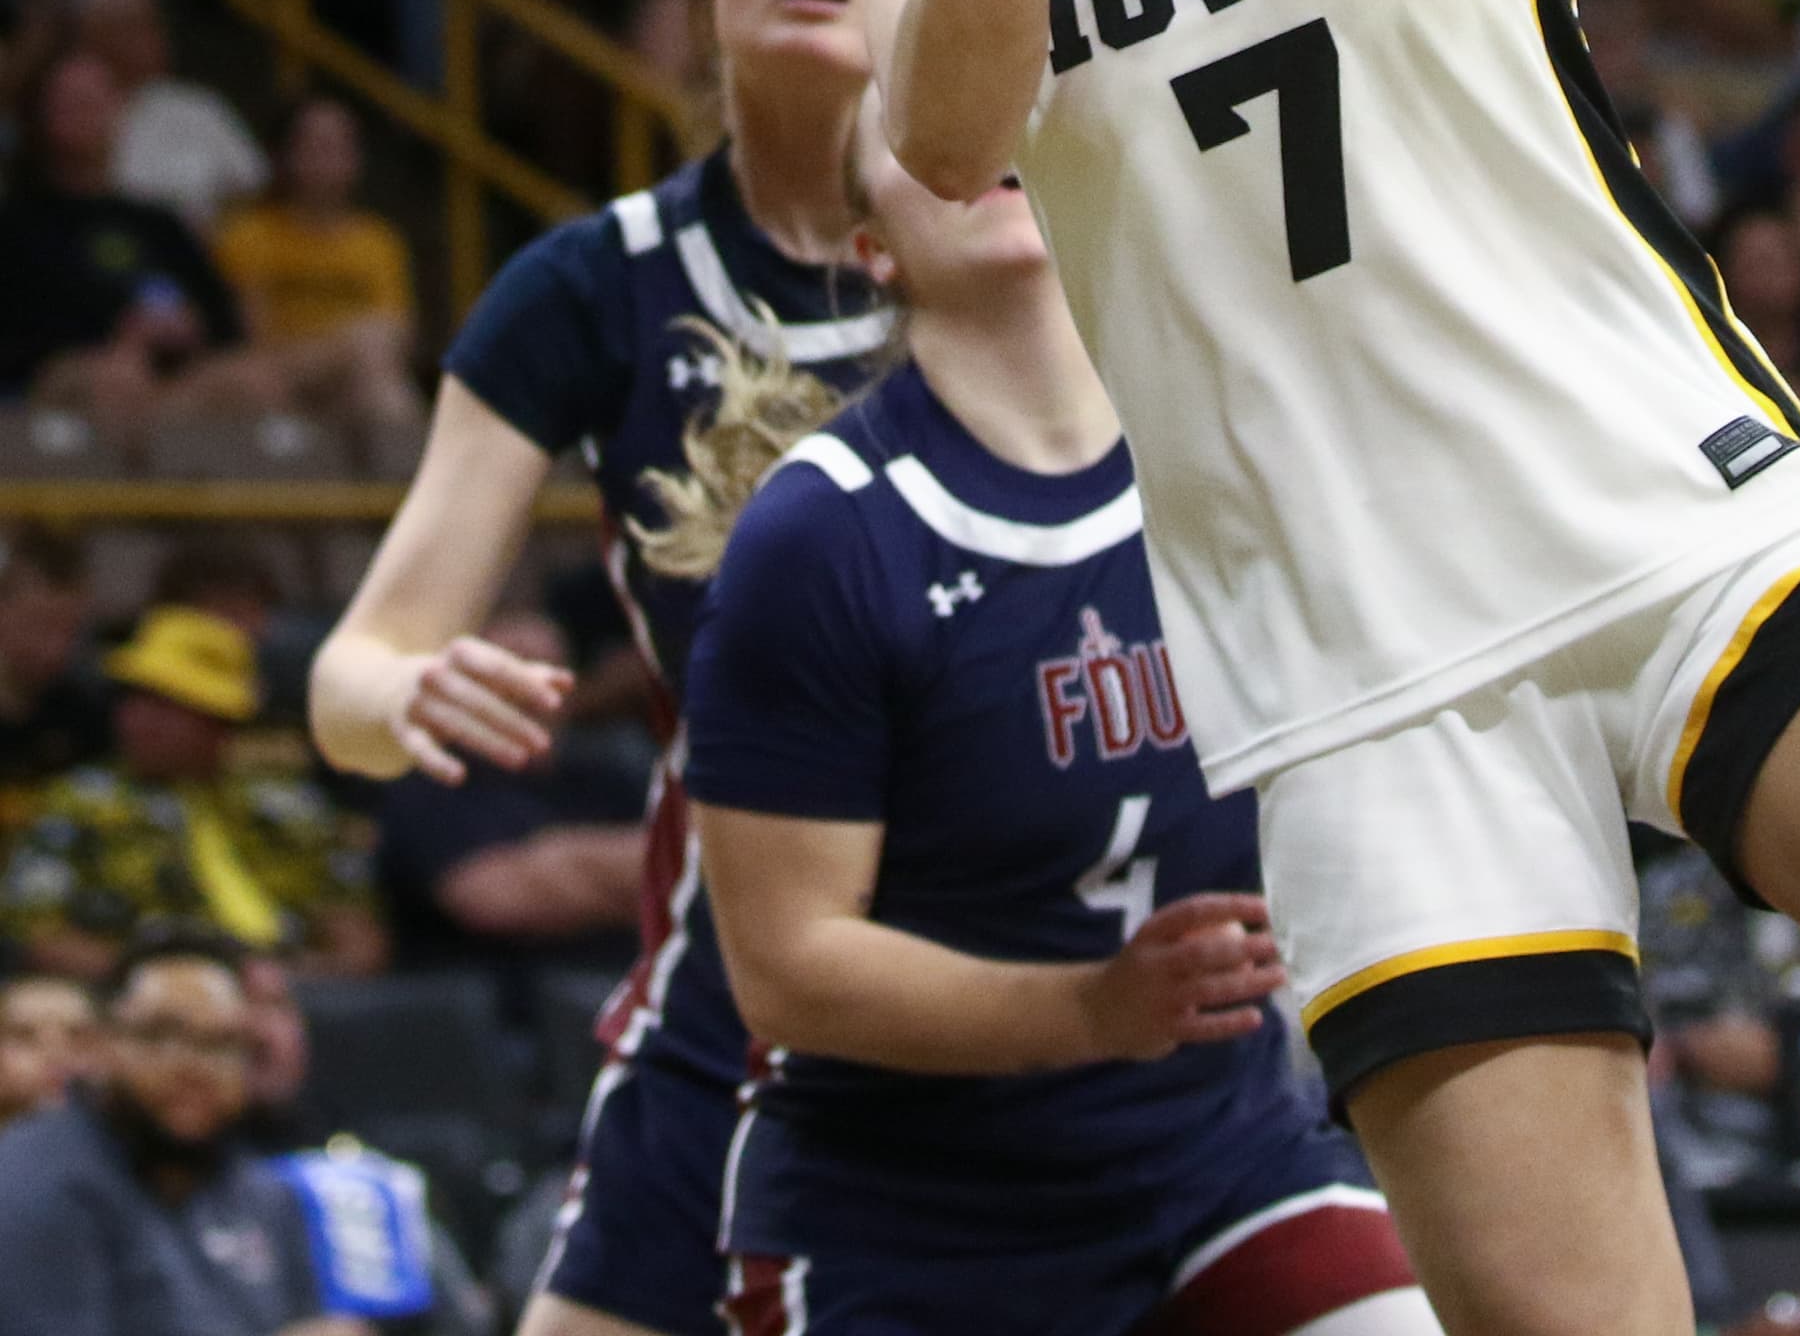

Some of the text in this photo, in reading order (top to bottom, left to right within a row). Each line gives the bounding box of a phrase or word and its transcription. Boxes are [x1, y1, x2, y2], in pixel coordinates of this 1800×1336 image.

[1169, 17, 1352, 283] 7
[1036, 637, 1192, 771] FDU
[1072, 794, 1159, 944] 4
